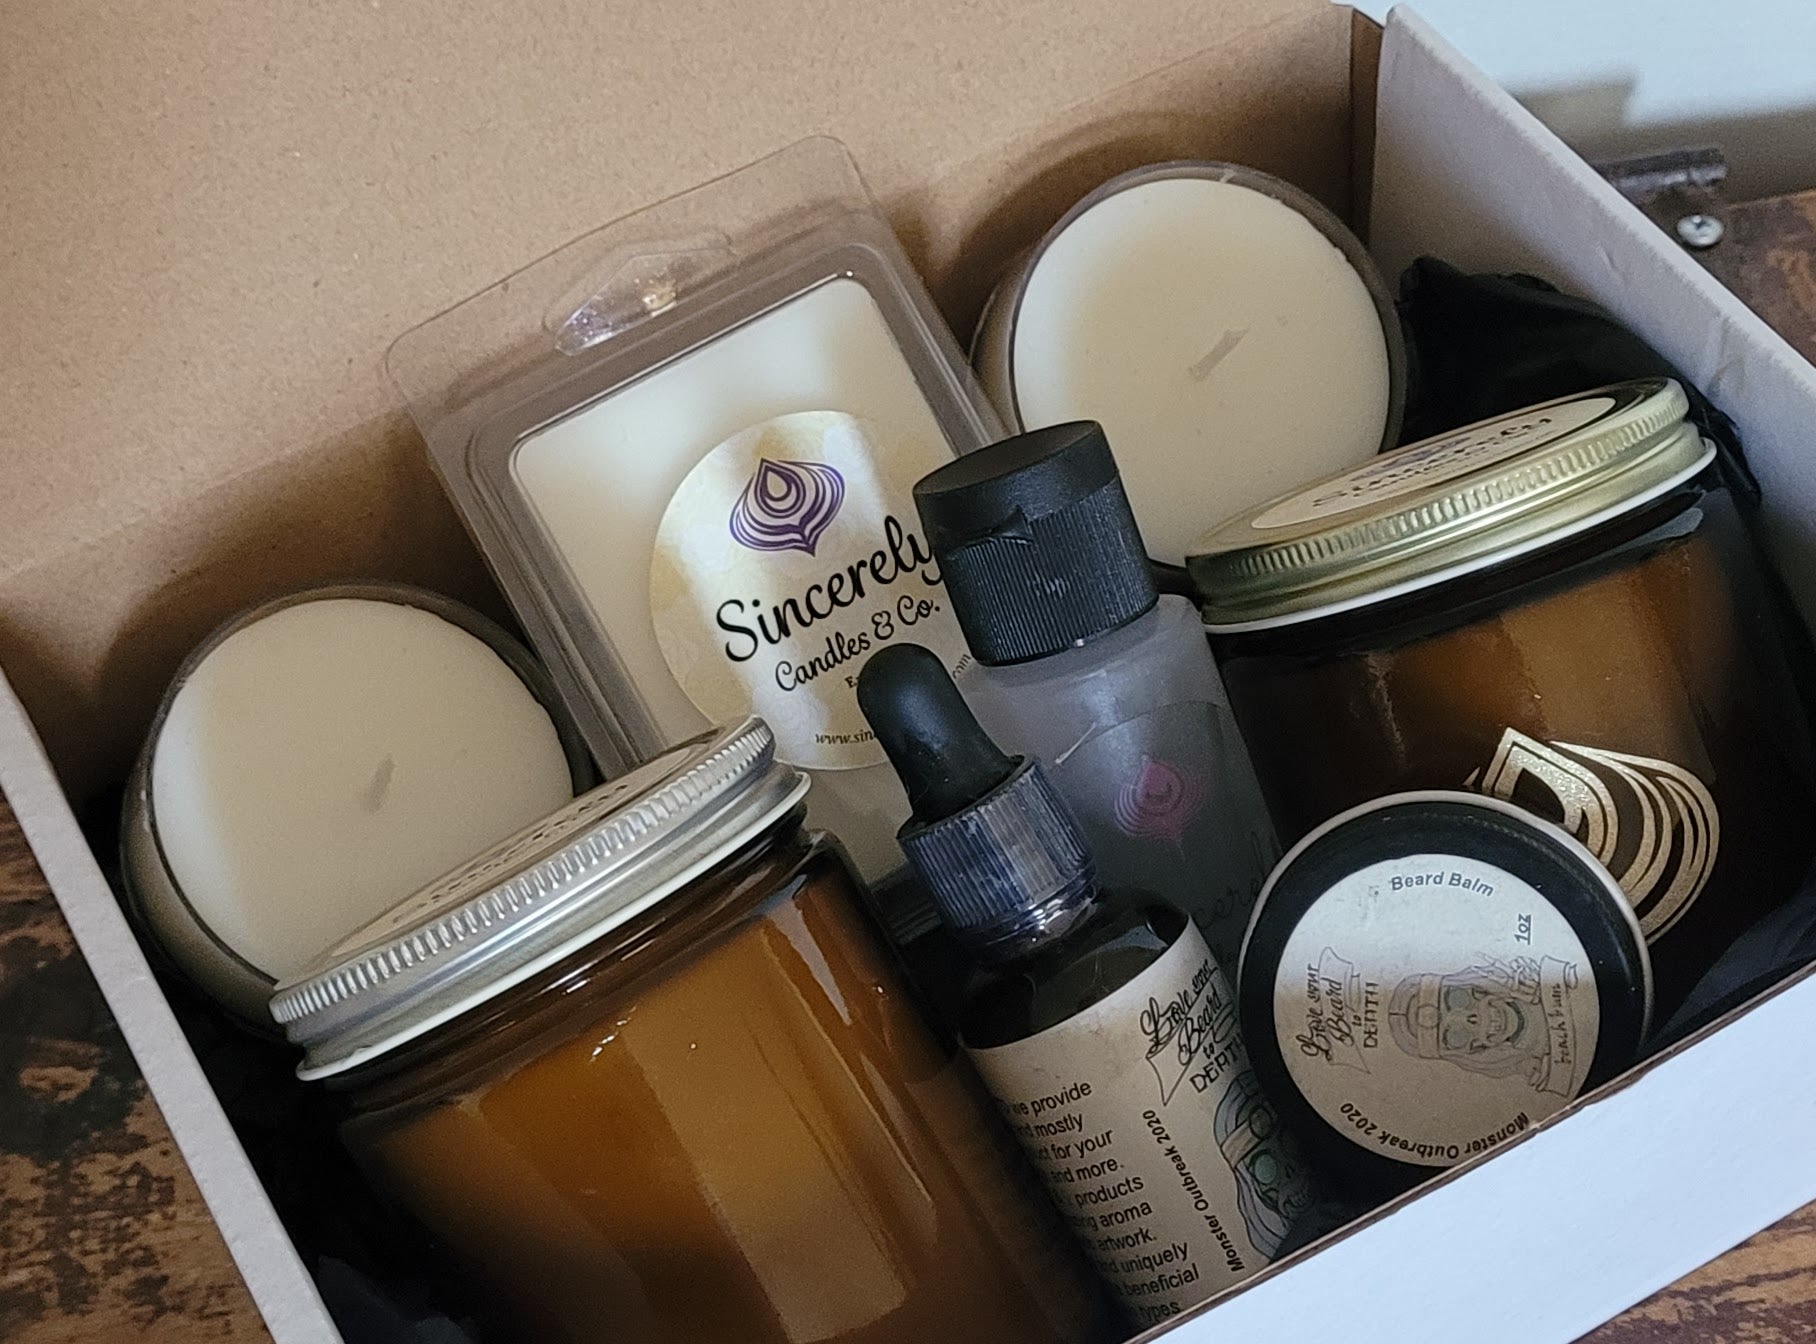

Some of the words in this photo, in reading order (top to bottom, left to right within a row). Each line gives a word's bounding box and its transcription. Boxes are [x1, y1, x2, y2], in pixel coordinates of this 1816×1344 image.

[716, 515, 944, 662] Sincerely
[775, 631, 871, 691] Candles
[871, 611, 895, 641] &
[897, 595, 941, 626] Co.
[1391, 871, 1444, 893] Beard
[1448, 872, 1494, 897] Balm
[1514, 914, 1532, 945] 1oz
[1030, 1081, 1093, 1117] provide
[1034, 1111, 1084, 1140] mostly
[1141, 1108, 1172, 1146] 2020
[1340, 1102, 1378, 1137] 2020
[1464, 1112, 1530, 1154] Monster
[1051, 1140, 1074, 1163] for
[1073, 1128, 1114, 1157] your
[1377, 1130, 1459, 1159] Outbreak
[1075, 1175, 1145, 1211] products
[1164, 1144, 1210, 1212] Outbreak
[1099, 1201, 1153, 1228] aroma
[1121, 1242, 1189, 1279] uniquely
[1203, 1213, 1245, 1272] Monster
